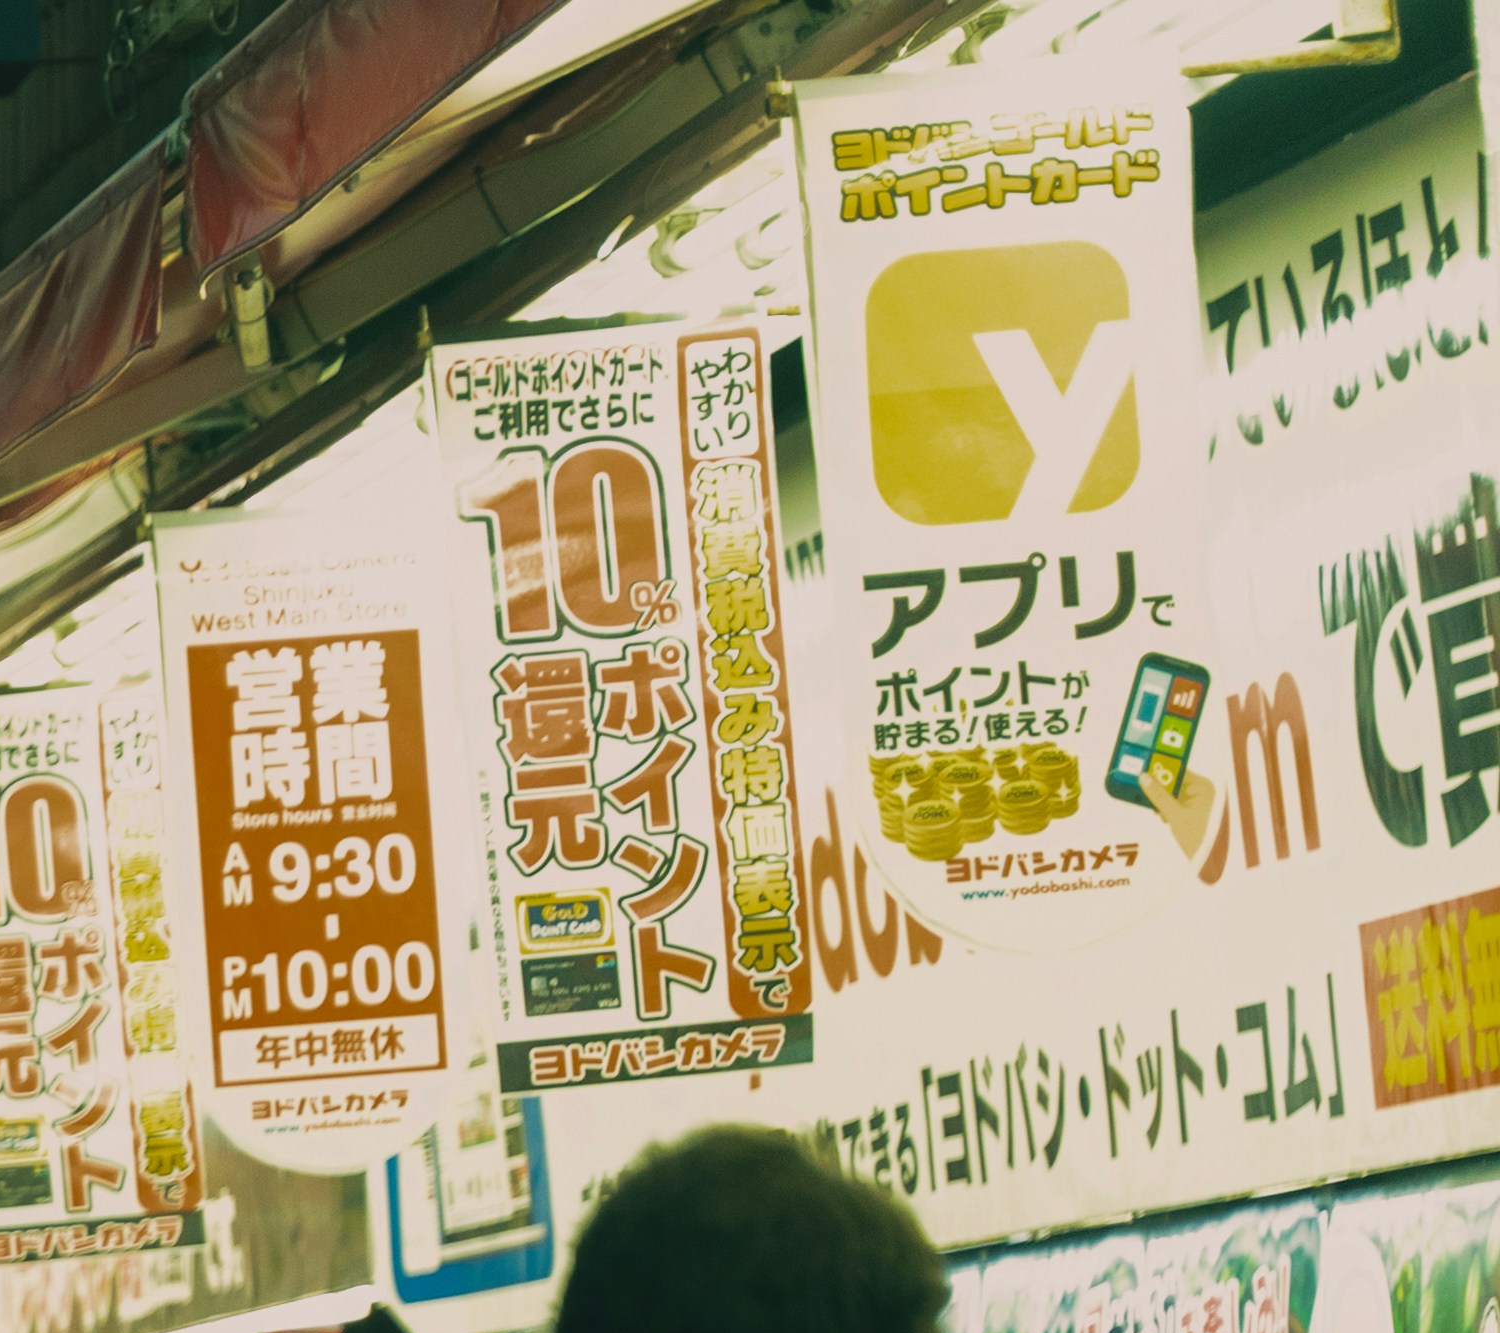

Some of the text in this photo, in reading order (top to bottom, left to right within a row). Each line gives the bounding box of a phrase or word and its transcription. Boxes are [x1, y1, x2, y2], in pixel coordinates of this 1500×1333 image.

[832, 103, 1154, 171] ヨドバシゴールド
[840, 148, 1161, 222] ポイントカード
[474, 392, 655, 441] ご利用でさらに
[690, 358, 724, 453] やすい
[720, 346, 751, 441] わかり
[457, 435, 682, 645] 10%
[191, 600, 408, 634] West Main Store
[863, 550, 1176, 659] アプリで
[226, 640, 391, 732] 営業
[875, 660, 1090, 717] ポイントが
[230, 719, 393, 808] 時間
[491, 647, 608, 877] 還元
[697, 462, 799, 1011] 消費税込み特価表示で
[232, 811, 279, 830] Store
[282, 807, 333, 826] hours
[596, 637, 718, 1020] ポイント
[268, 832, 417, 904] 9:30
[946, 842, 1140, 884] ヨドバシカメラ
[960, 876, 1131, 901] www.yodobashi.com
[541, 902, 589, 922] GOLD
[251, 940, 436, 1014] 10:00
[37, 930, 125, 1213] ポイント
[255, 1025, 406, 1070] 年中無休
[530, 1023, 787, 1084] ヨドバシカメラ
[251, 1088, 410, 1120] ヨドバシカメラ
